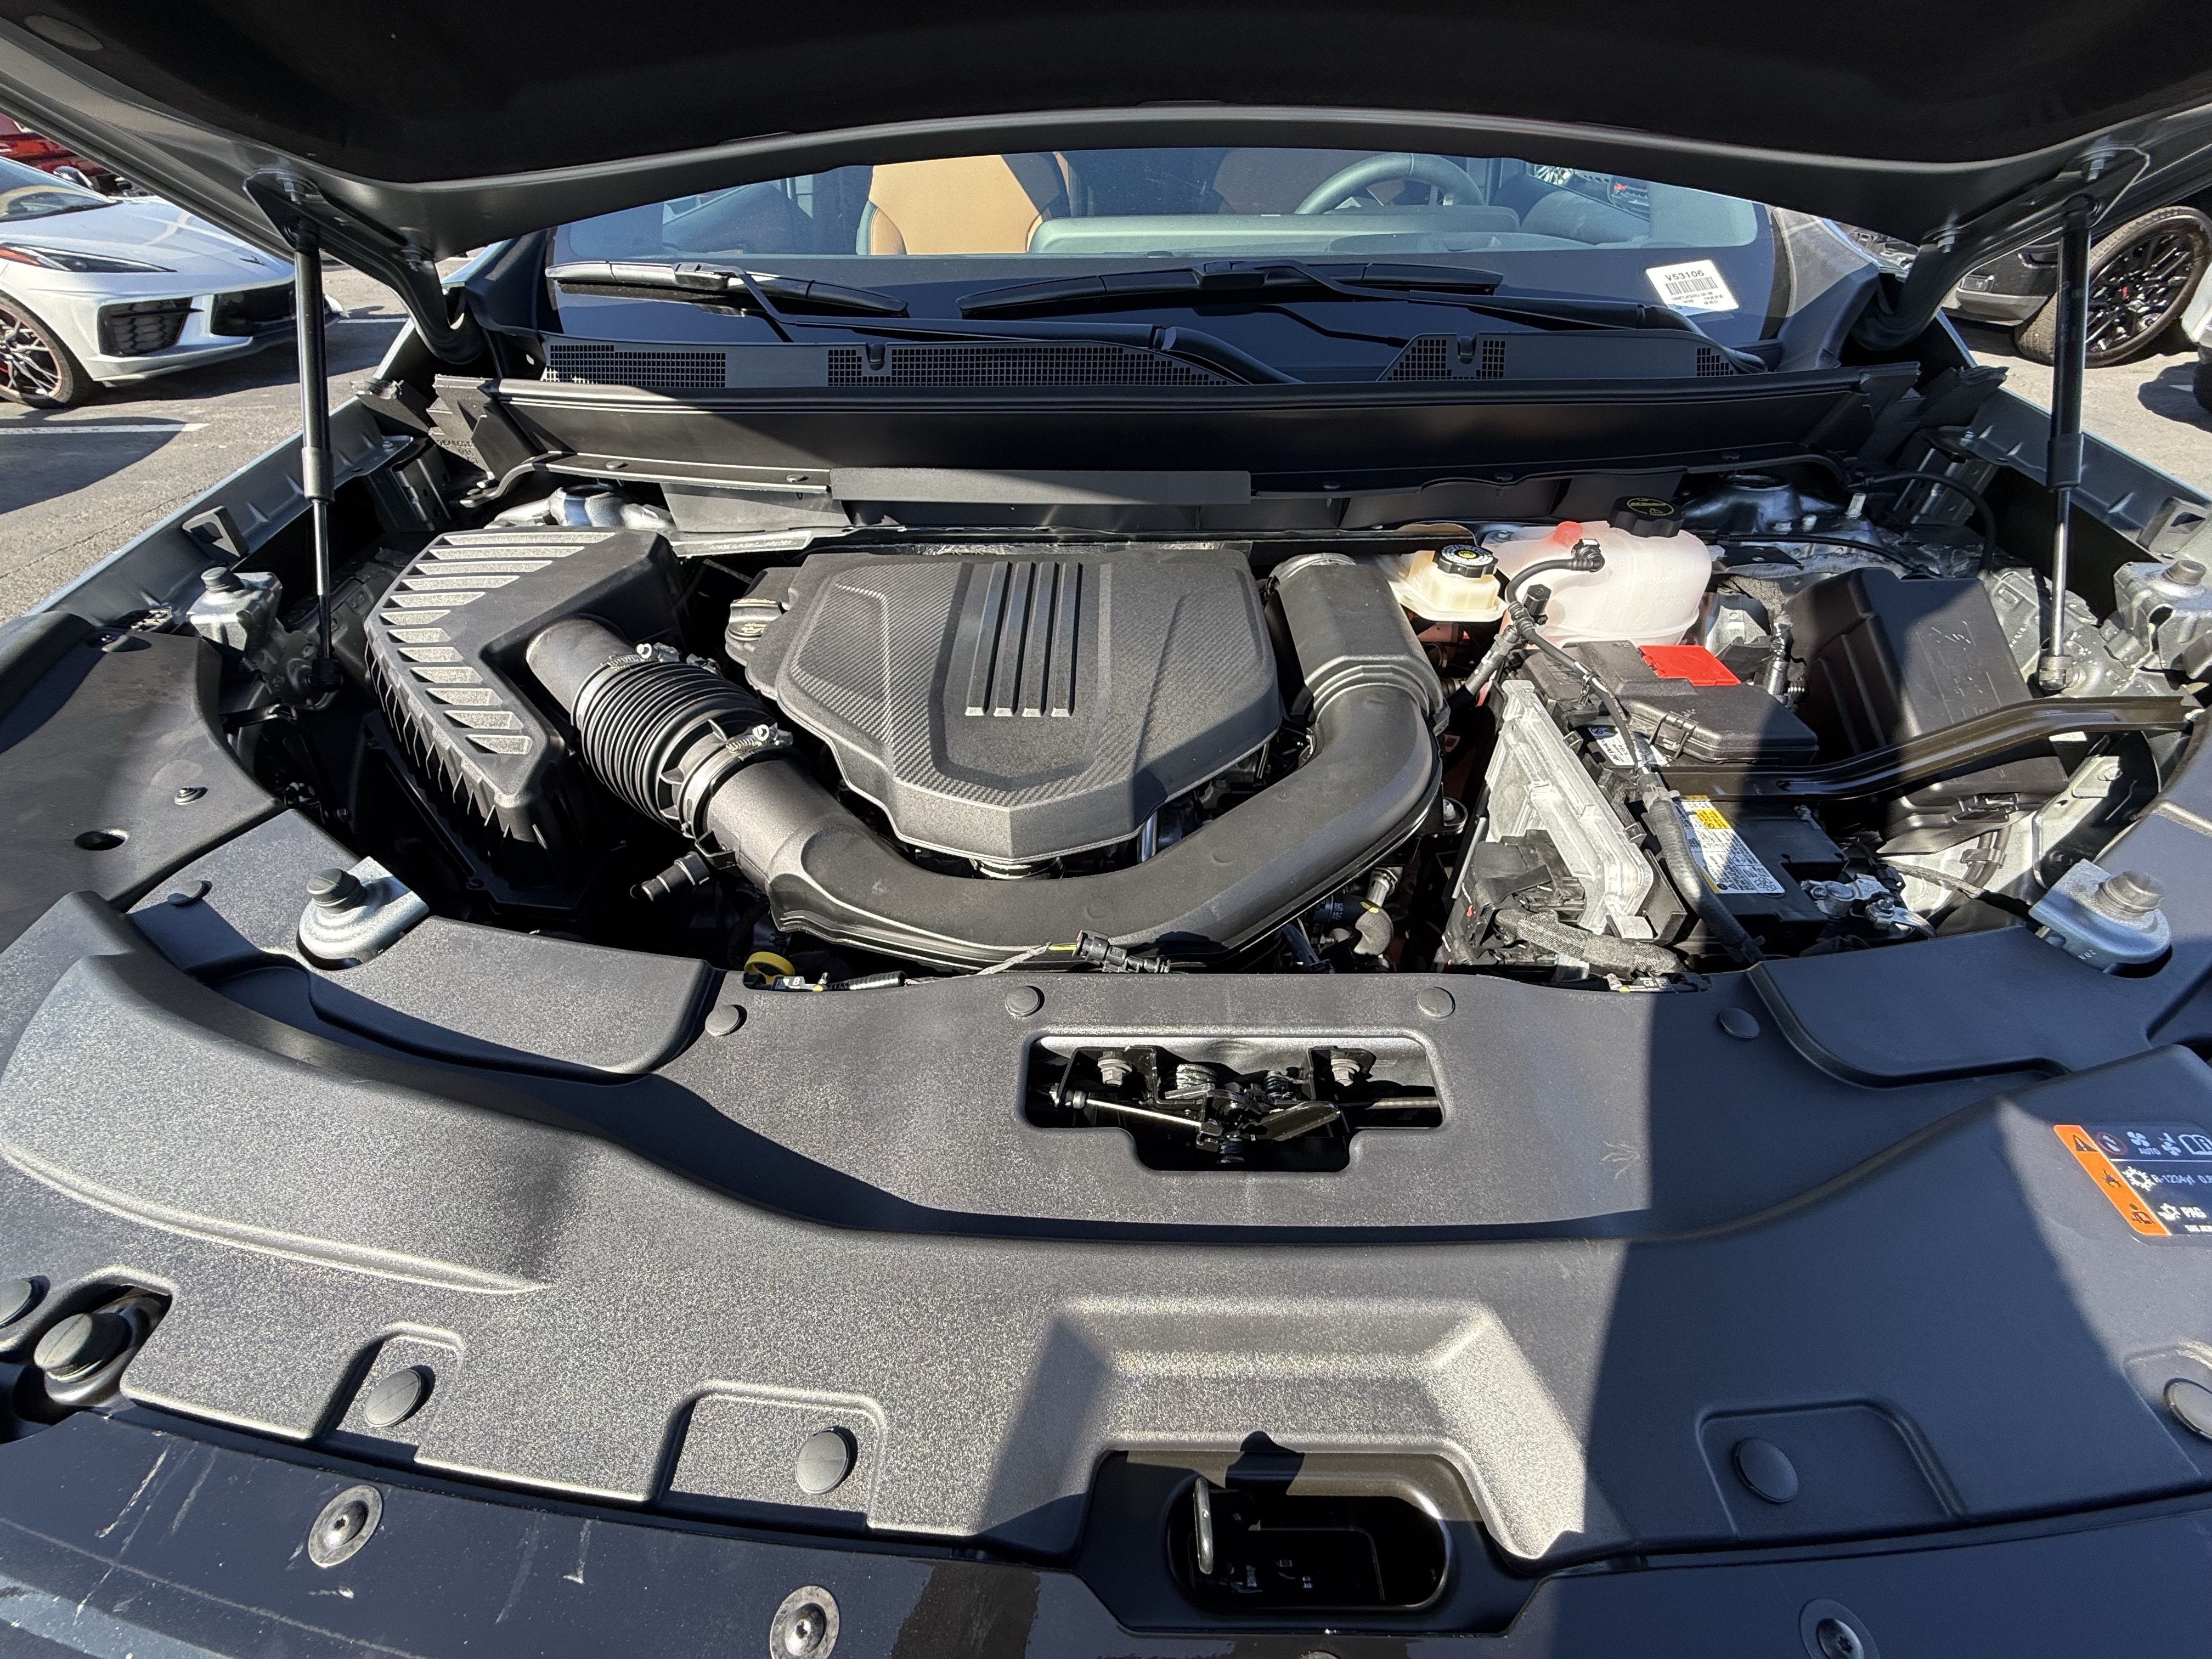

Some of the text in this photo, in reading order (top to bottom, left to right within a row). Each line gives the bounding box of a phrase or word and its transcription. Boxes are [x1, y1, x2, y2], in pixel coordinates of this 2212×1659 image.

[1664, 270, 1705, 281] V53106
[2138, 1147, 2162, 1155] AUTO
[2150, 1174, 2196, 1185] R-1234yf
[2180, 1206, 2207, 1218] PAG
